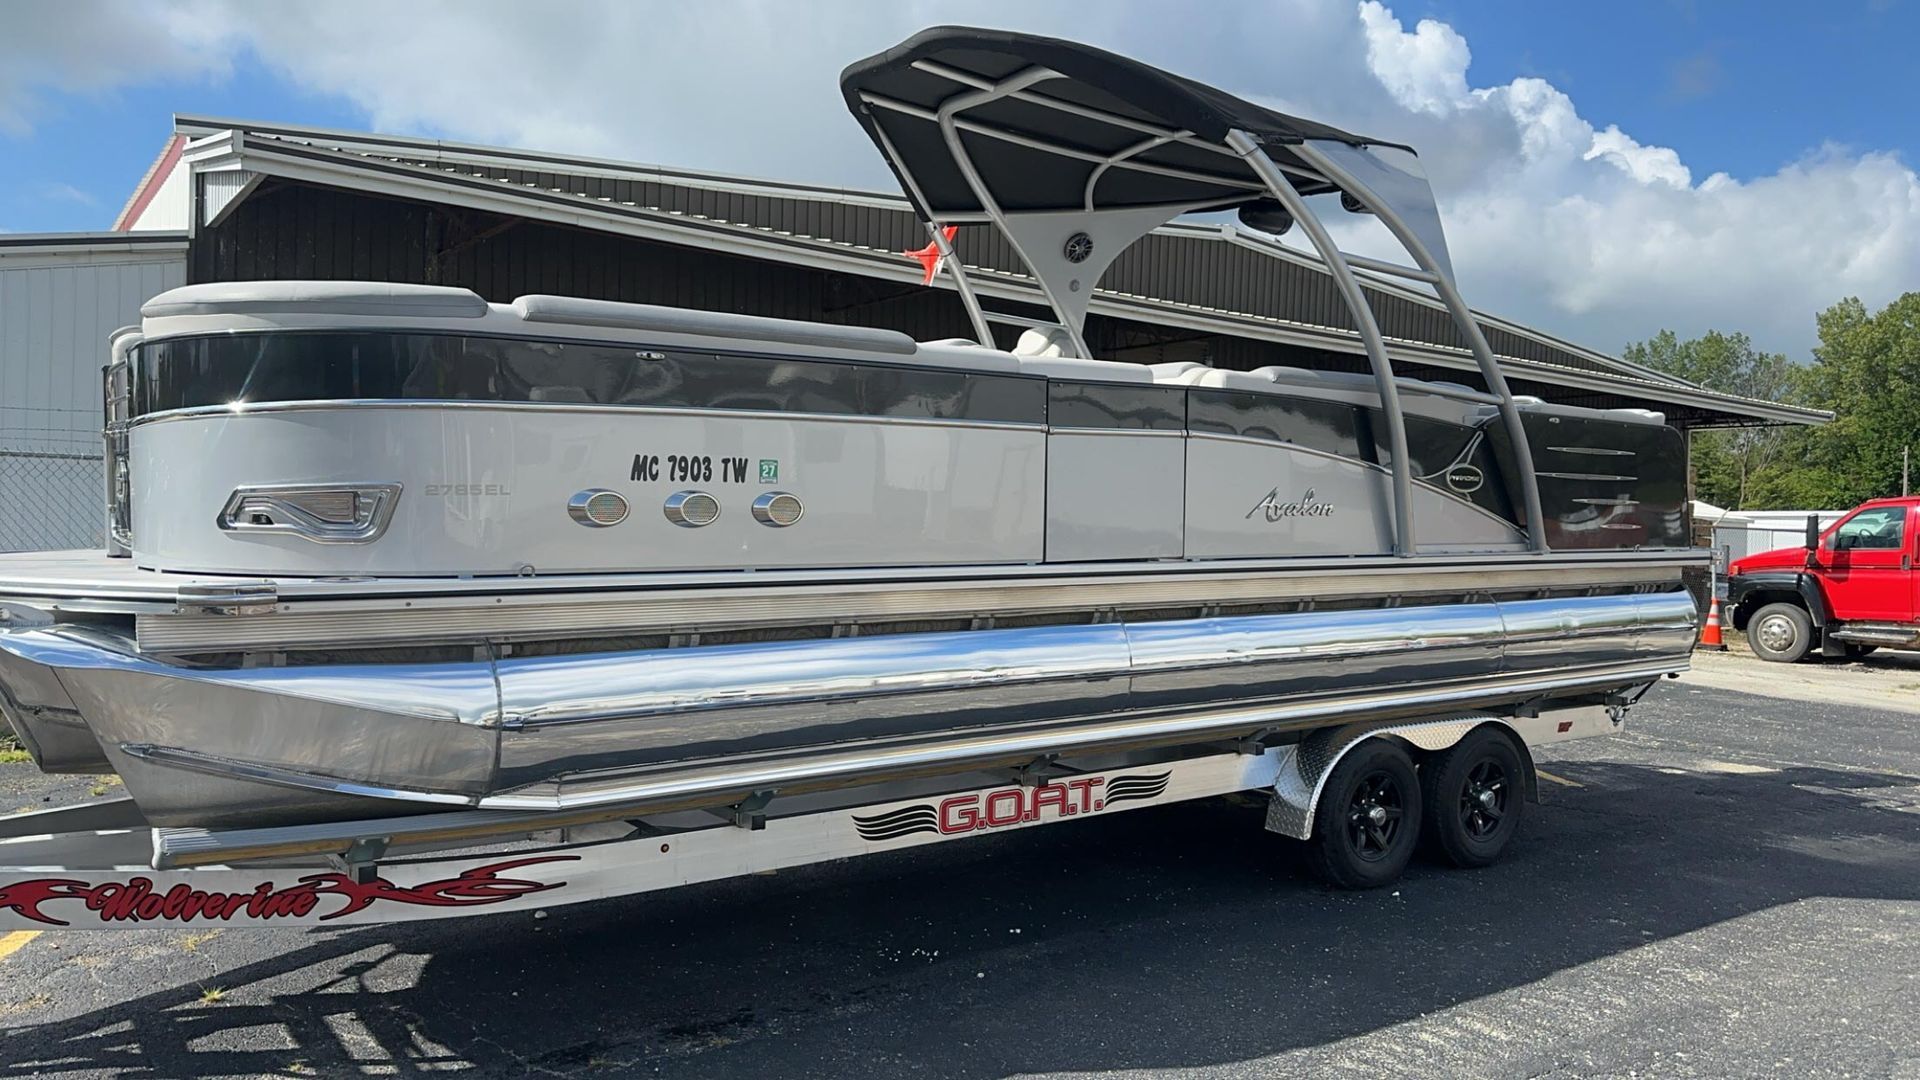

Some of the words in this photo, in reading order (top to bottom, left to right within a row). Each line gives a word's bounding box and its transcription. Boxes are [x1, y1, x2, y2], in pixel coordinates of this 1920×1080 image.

[630, 454, 659, 482] MC
[667, 454, 713, 482] 7903
[721, 457, 749, 483] TW
[762, 465, 775, 477] 27
[424, 484, 511, 496] 2785EL
[1245, 486, 1334, 523] Avalon
[938, 777, 1105, 835] G.O.A.T.
[86, 877, 320, 923] Wolverine
